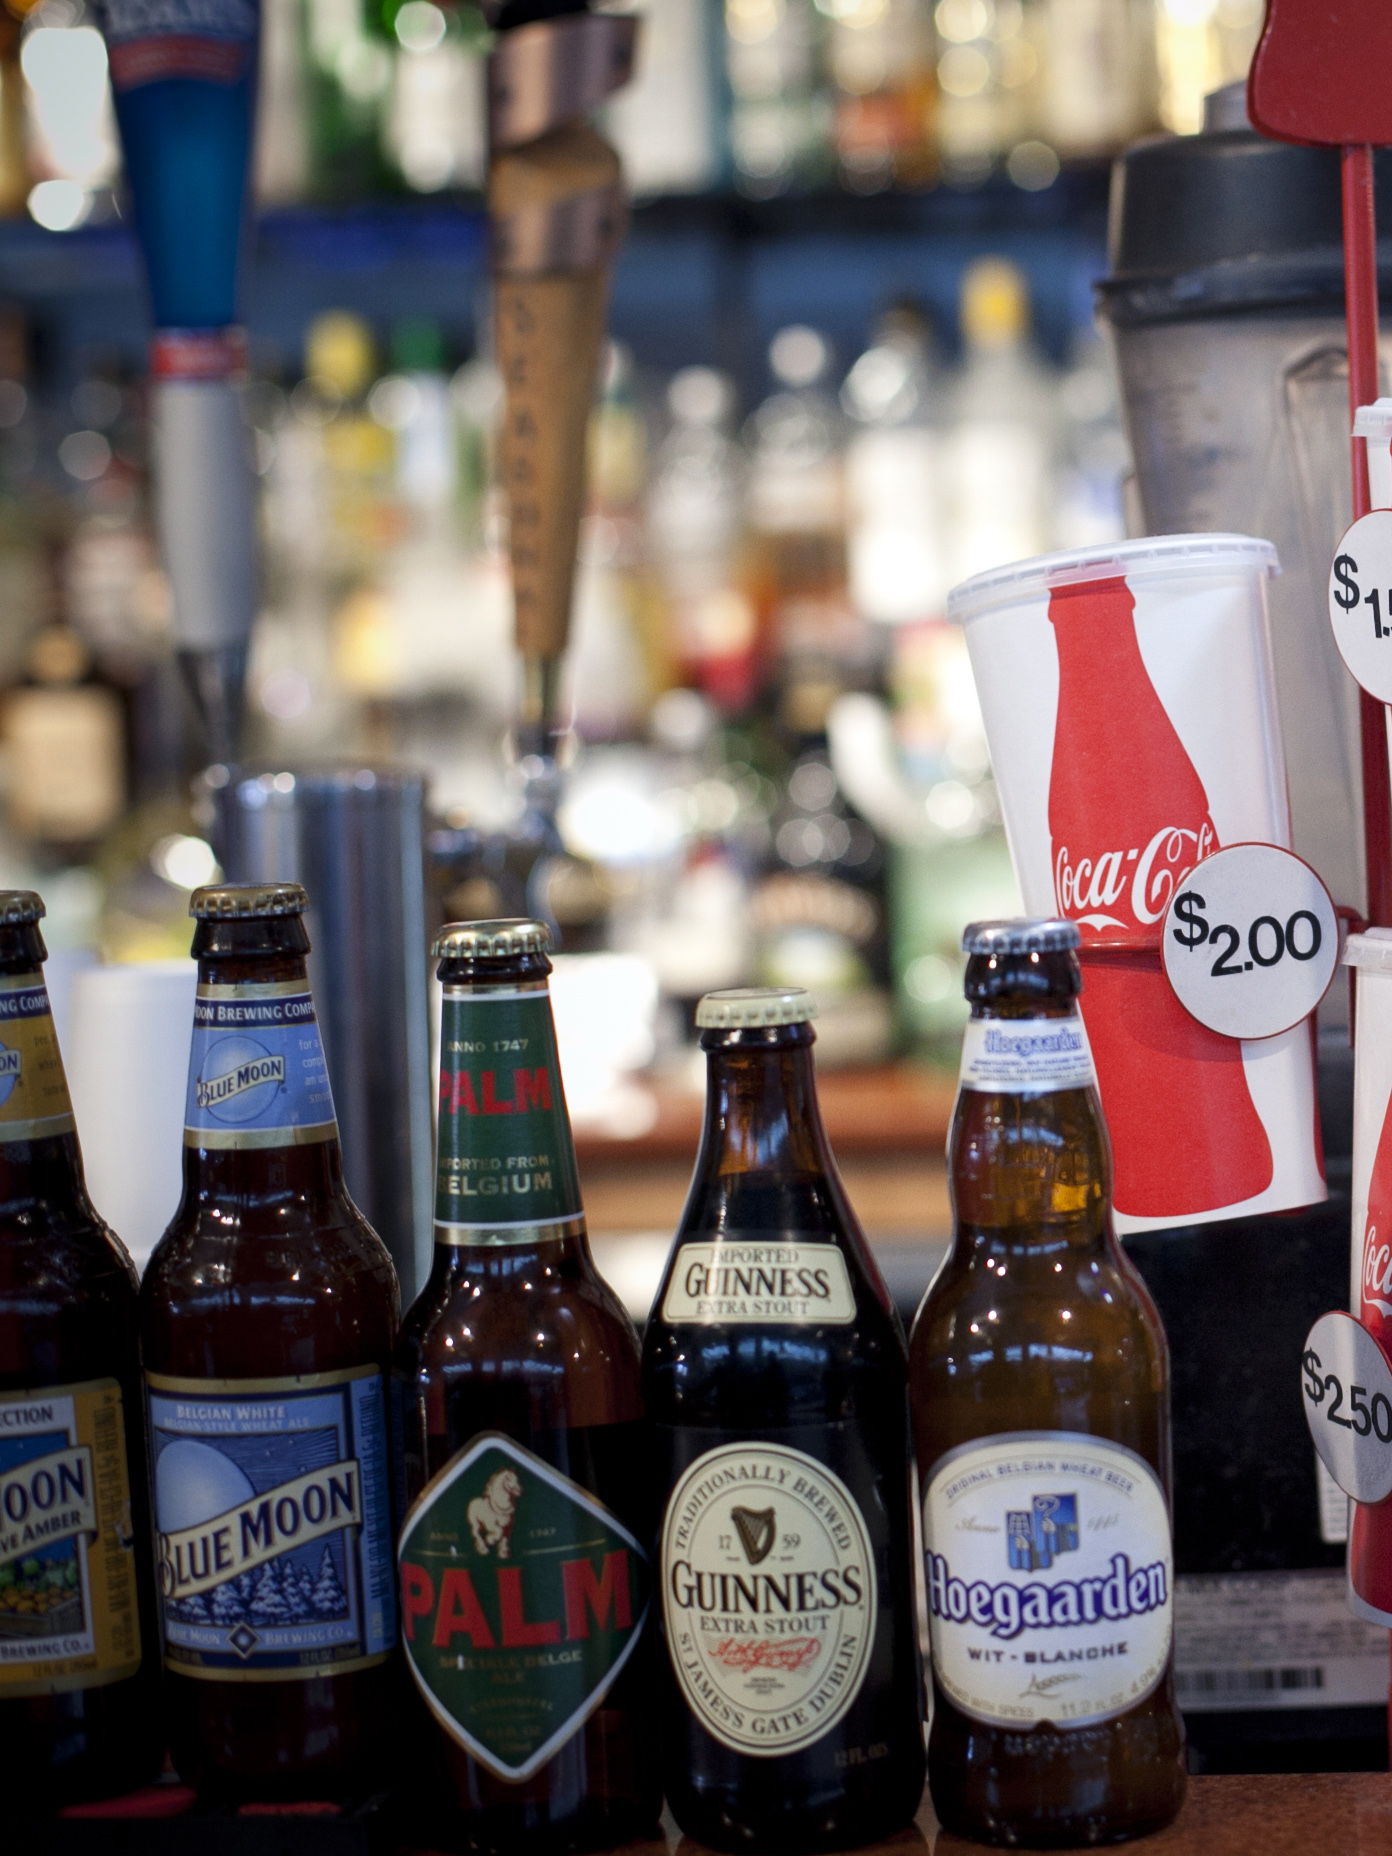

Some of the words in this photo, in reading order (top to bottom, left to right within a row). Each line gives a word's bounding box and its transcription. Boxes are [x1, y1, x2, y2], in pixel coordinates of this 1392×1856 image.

[1056, 823, 1214, 931] Coca-C
[1173, 890, 1322, 977] $2.00
[20, 995, 50, 1012] COMP
[195, 1004, 214, 1020] OON
[217, 1005, 282, 1021] BREWING
[284, 1001, 316, 1017] COMPA
[984, 1026, 1082, 1057] Hoegaarden
[198, 1077, 235, 1108] BLUE
[237, 1060, 282, 1089] MOON
[438, 1066, 553, 1116] PALM
[505, 1154, 549, 1169] FROM
[711, 1249, 799, 1265] IMPORTED
[685, 1263, 832, 1299] GUINNESS
[696, 1300, 748, 1315] EXTRA
[753, 1300, 810, 1315] STOUT
[176, 1405, 232, 1421] BELGIAN
[236, 1405, 286, 1421] WHITE
[2, 1458, 85, 1524] OON
[675, 1464, 790, 1550] TRADITIONALLY
[793, 1477, 852, 1550] BREWED
[22, 1510, 82, 1543] AMBER
[159, 1526, 233, 1599] BLUE
[239, 1471, 355, 1560] MOON
[718, 1534, 732, 1550] 17
[400, 1548, 634, 1650] PALM
[671, 1559, 863, 1614] GUINNESS
[926, 1549, 1167, 1640] Hoegaarden
[265, 1628, 326, 1646] BREWING
[700, 1615, 758, 1635] EXTRA
[764, 1614, 830, 1634] STOUT
[524, 1650, 583, 1669] BELGE
[967, 1646, 1004, 1663] WIT
[1024, 1641, 1129, 1664] BLANCHE
[751, 1706, 810, 1735] GATE
[809, 1632, 858, 1715] DUBLIN
